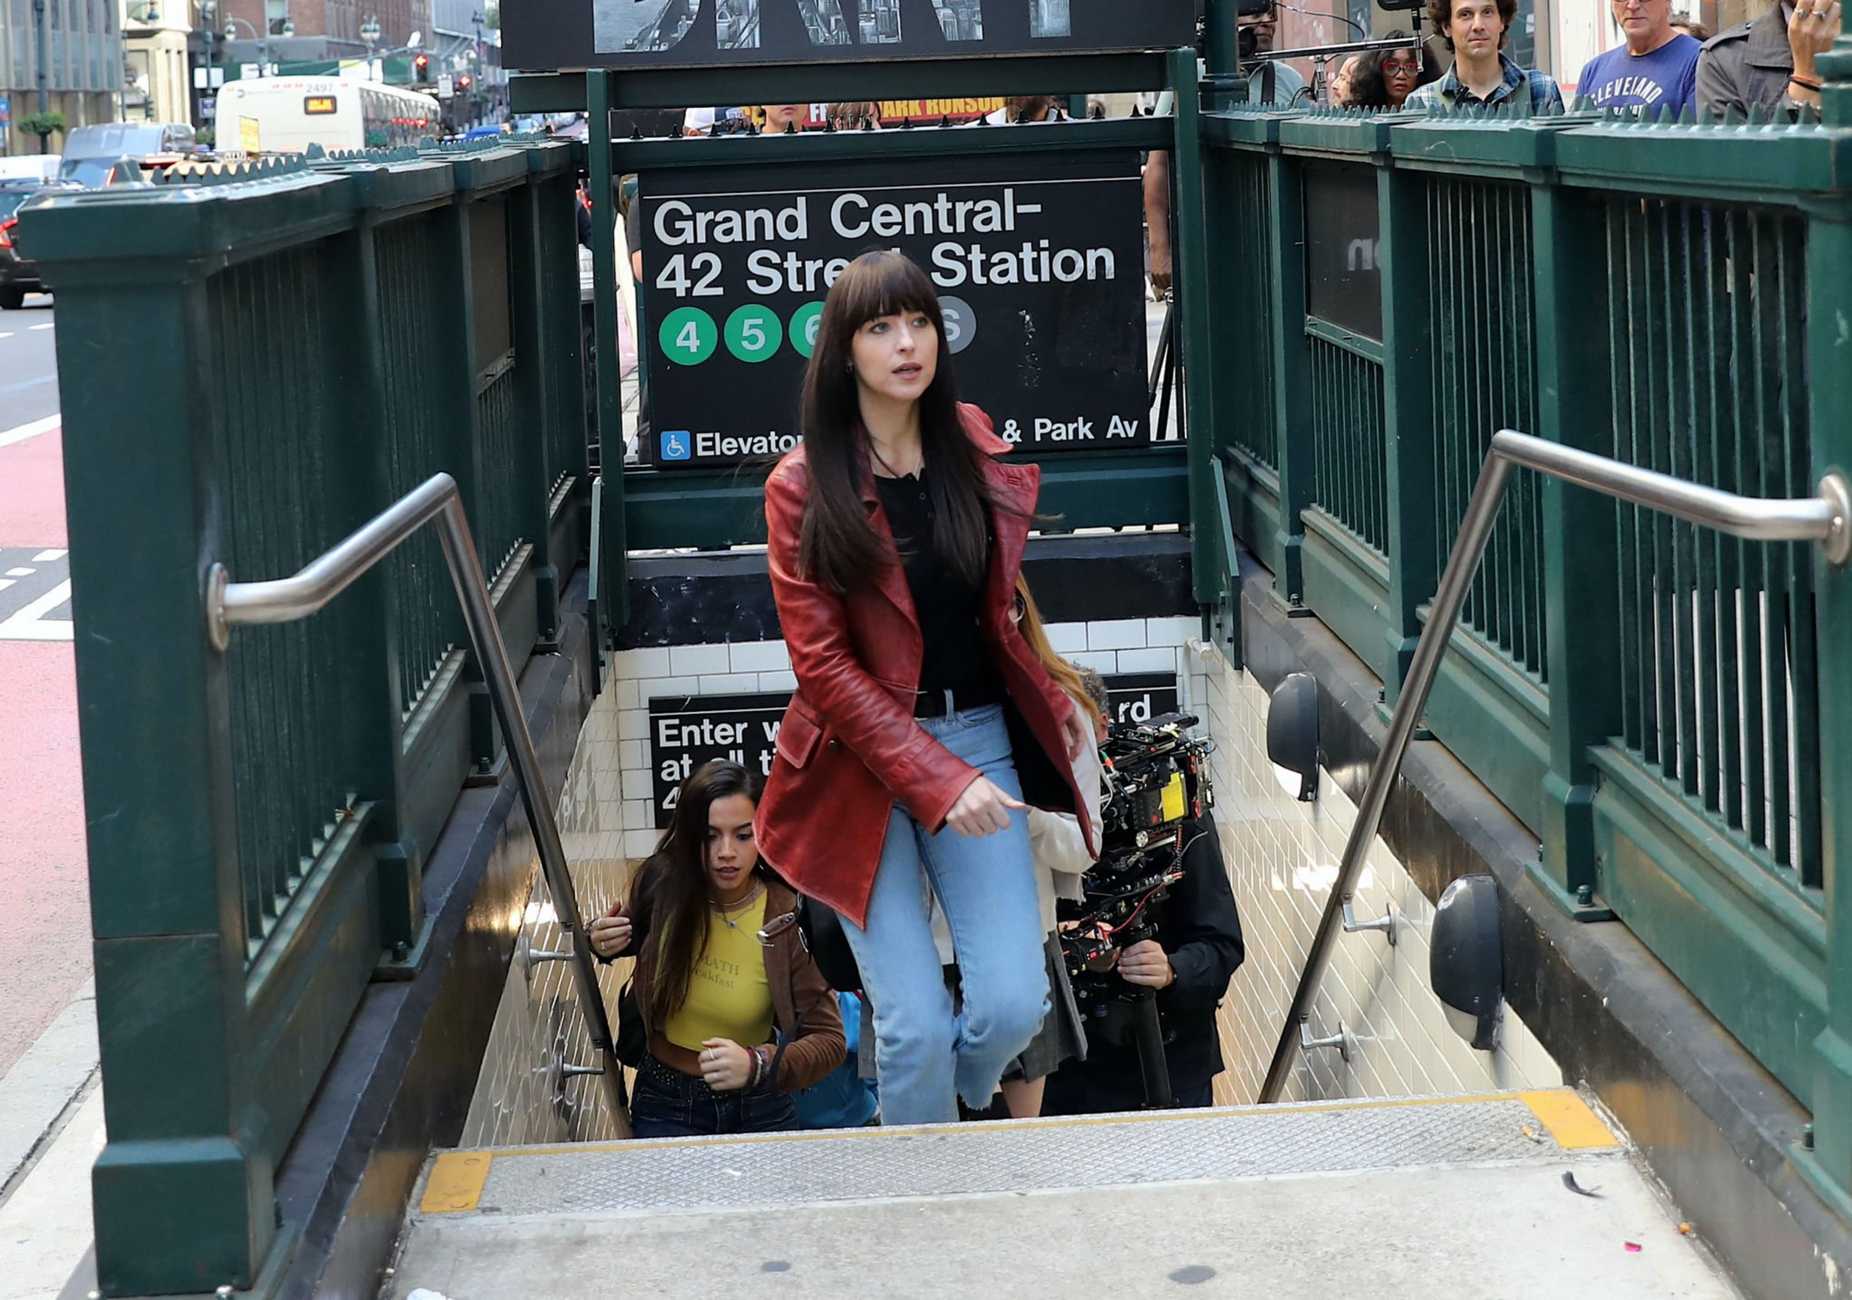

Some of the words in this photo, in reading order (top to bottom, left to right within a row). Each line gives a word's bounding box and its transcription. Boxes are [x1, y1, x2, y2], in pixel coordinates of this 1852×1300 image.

[881, 100, 924, 119] ARK
[653, 197, 808, 246] Grand
[830, 188, 1042, 239] Central-
[655, 250, 724, 297] 42
[746, 248, 901, 295] Stre
[930, 239, 1115, 288] Station
[676, 321, 701, 353] 4
[740, 318, 766, 351] 5
[1002, 419, 1022, 443] &
[1034, 416, 1095, 442] Park
[1105, 415, 1139, 439] Av
[658, 718, 748, 748] Enter
[660, 753, 693, 782] at
